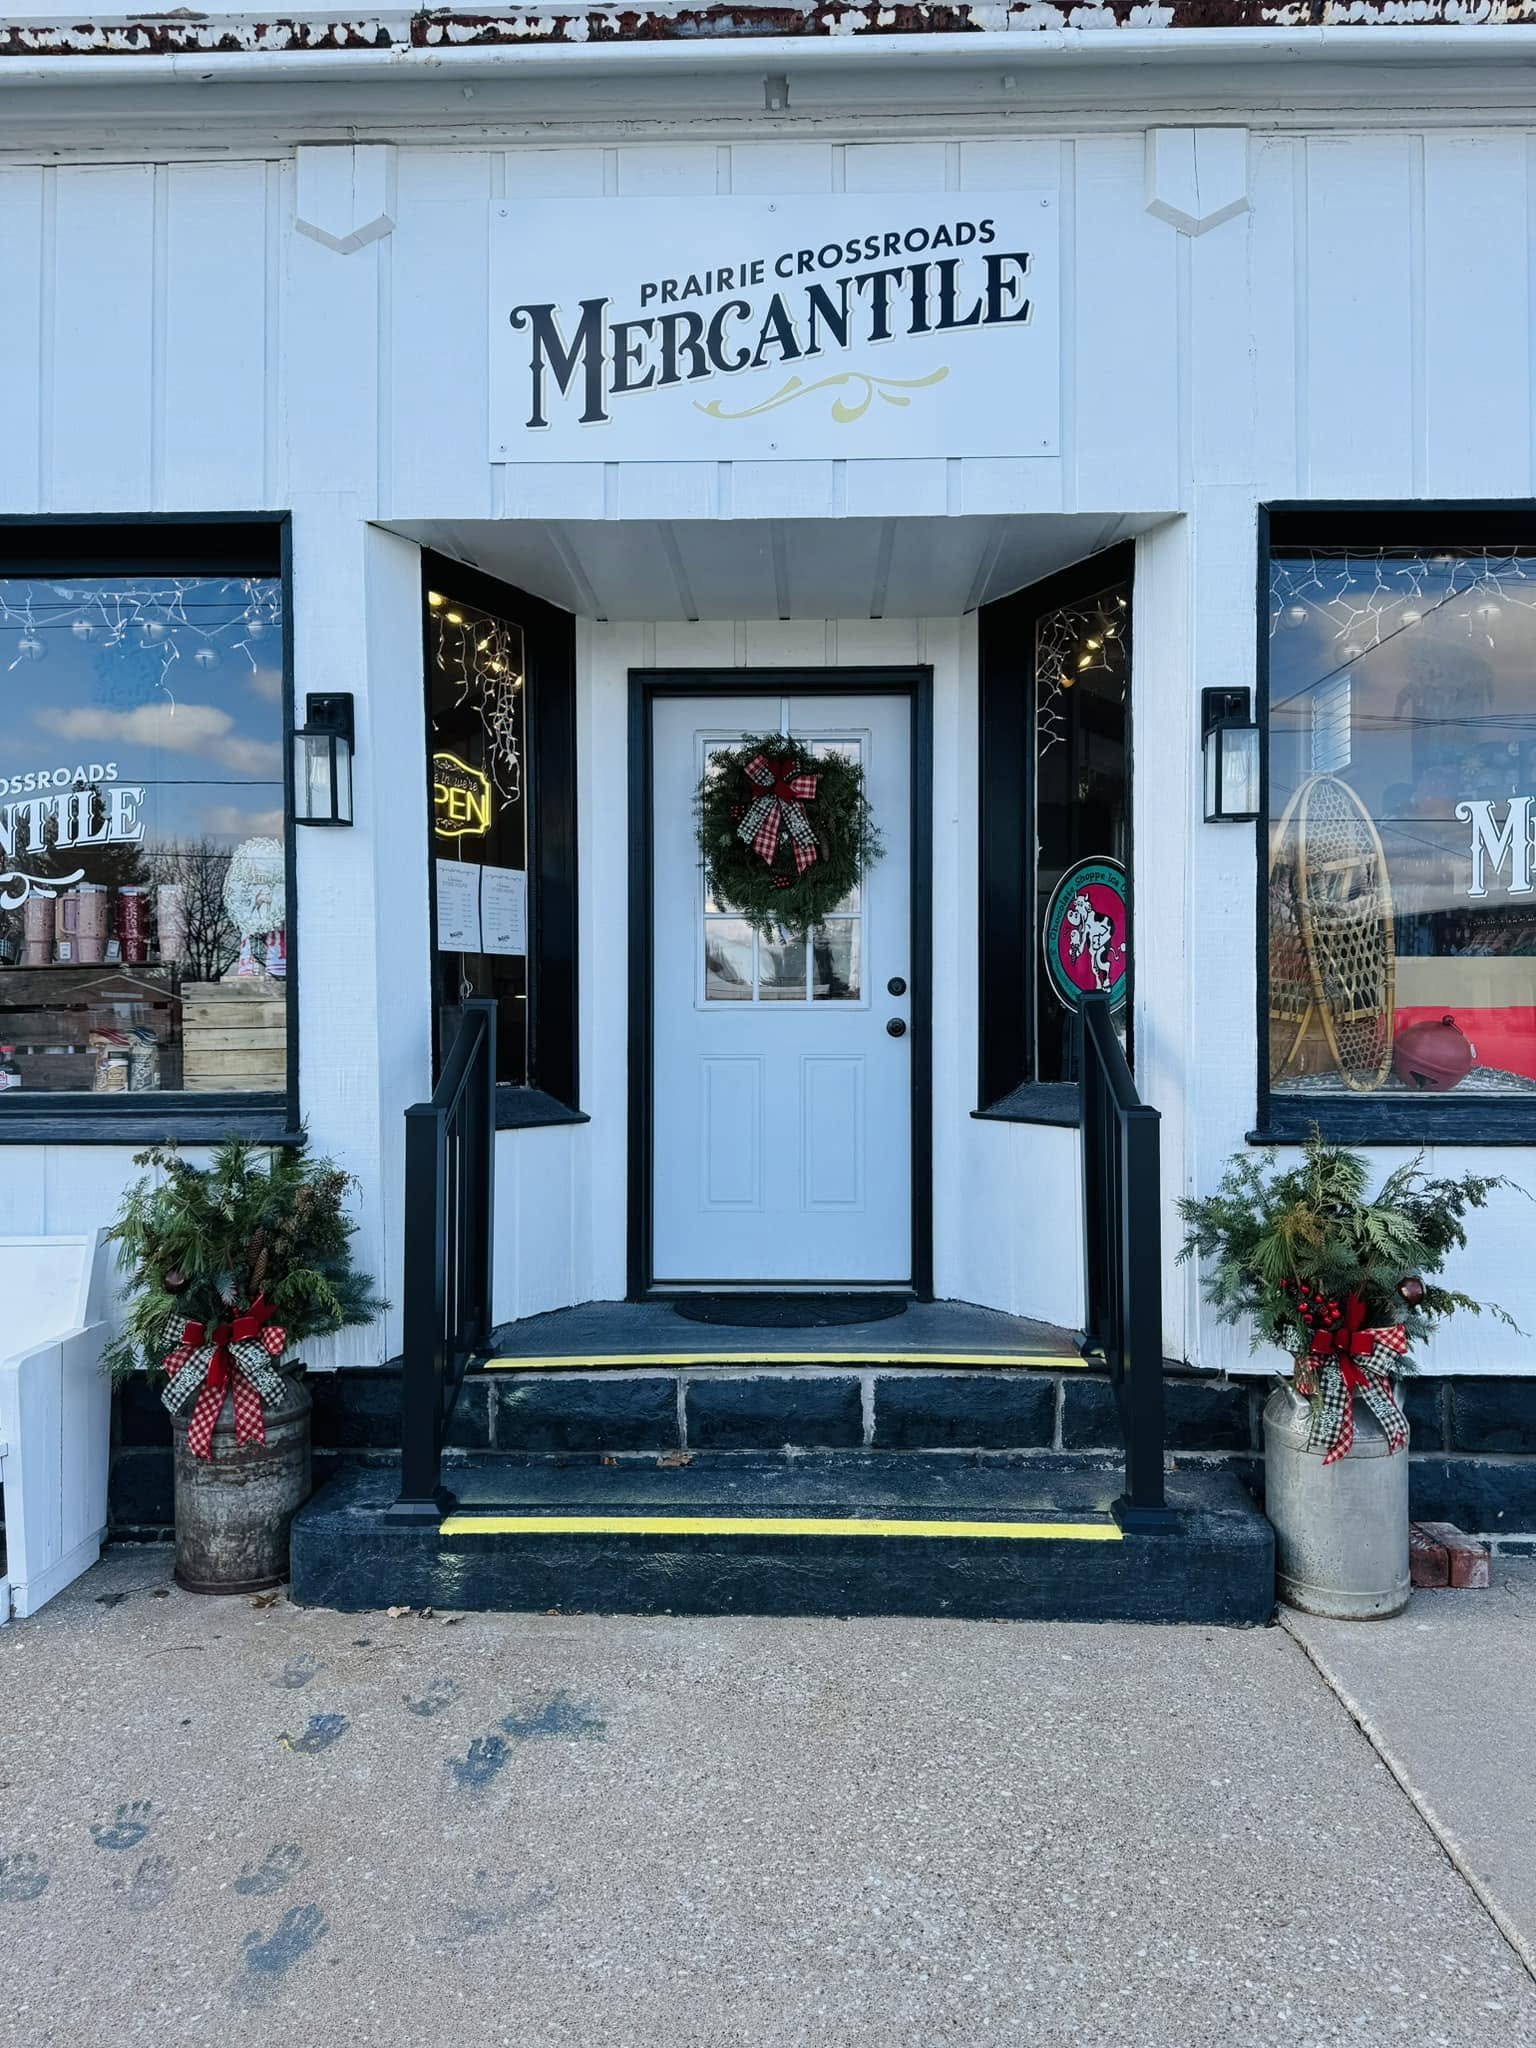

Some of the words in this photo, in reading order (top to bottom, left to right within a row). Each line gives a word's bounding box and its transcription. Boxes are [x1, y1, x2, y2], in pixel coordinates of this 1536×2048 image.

[640, 259, 765, 307] PRAIRIE
[775, 219, 996, 279] CROSSROADS
[509, 252, 1033, 429] MERCANTILE
[1074, 871, 1105, 886] Shoppe
